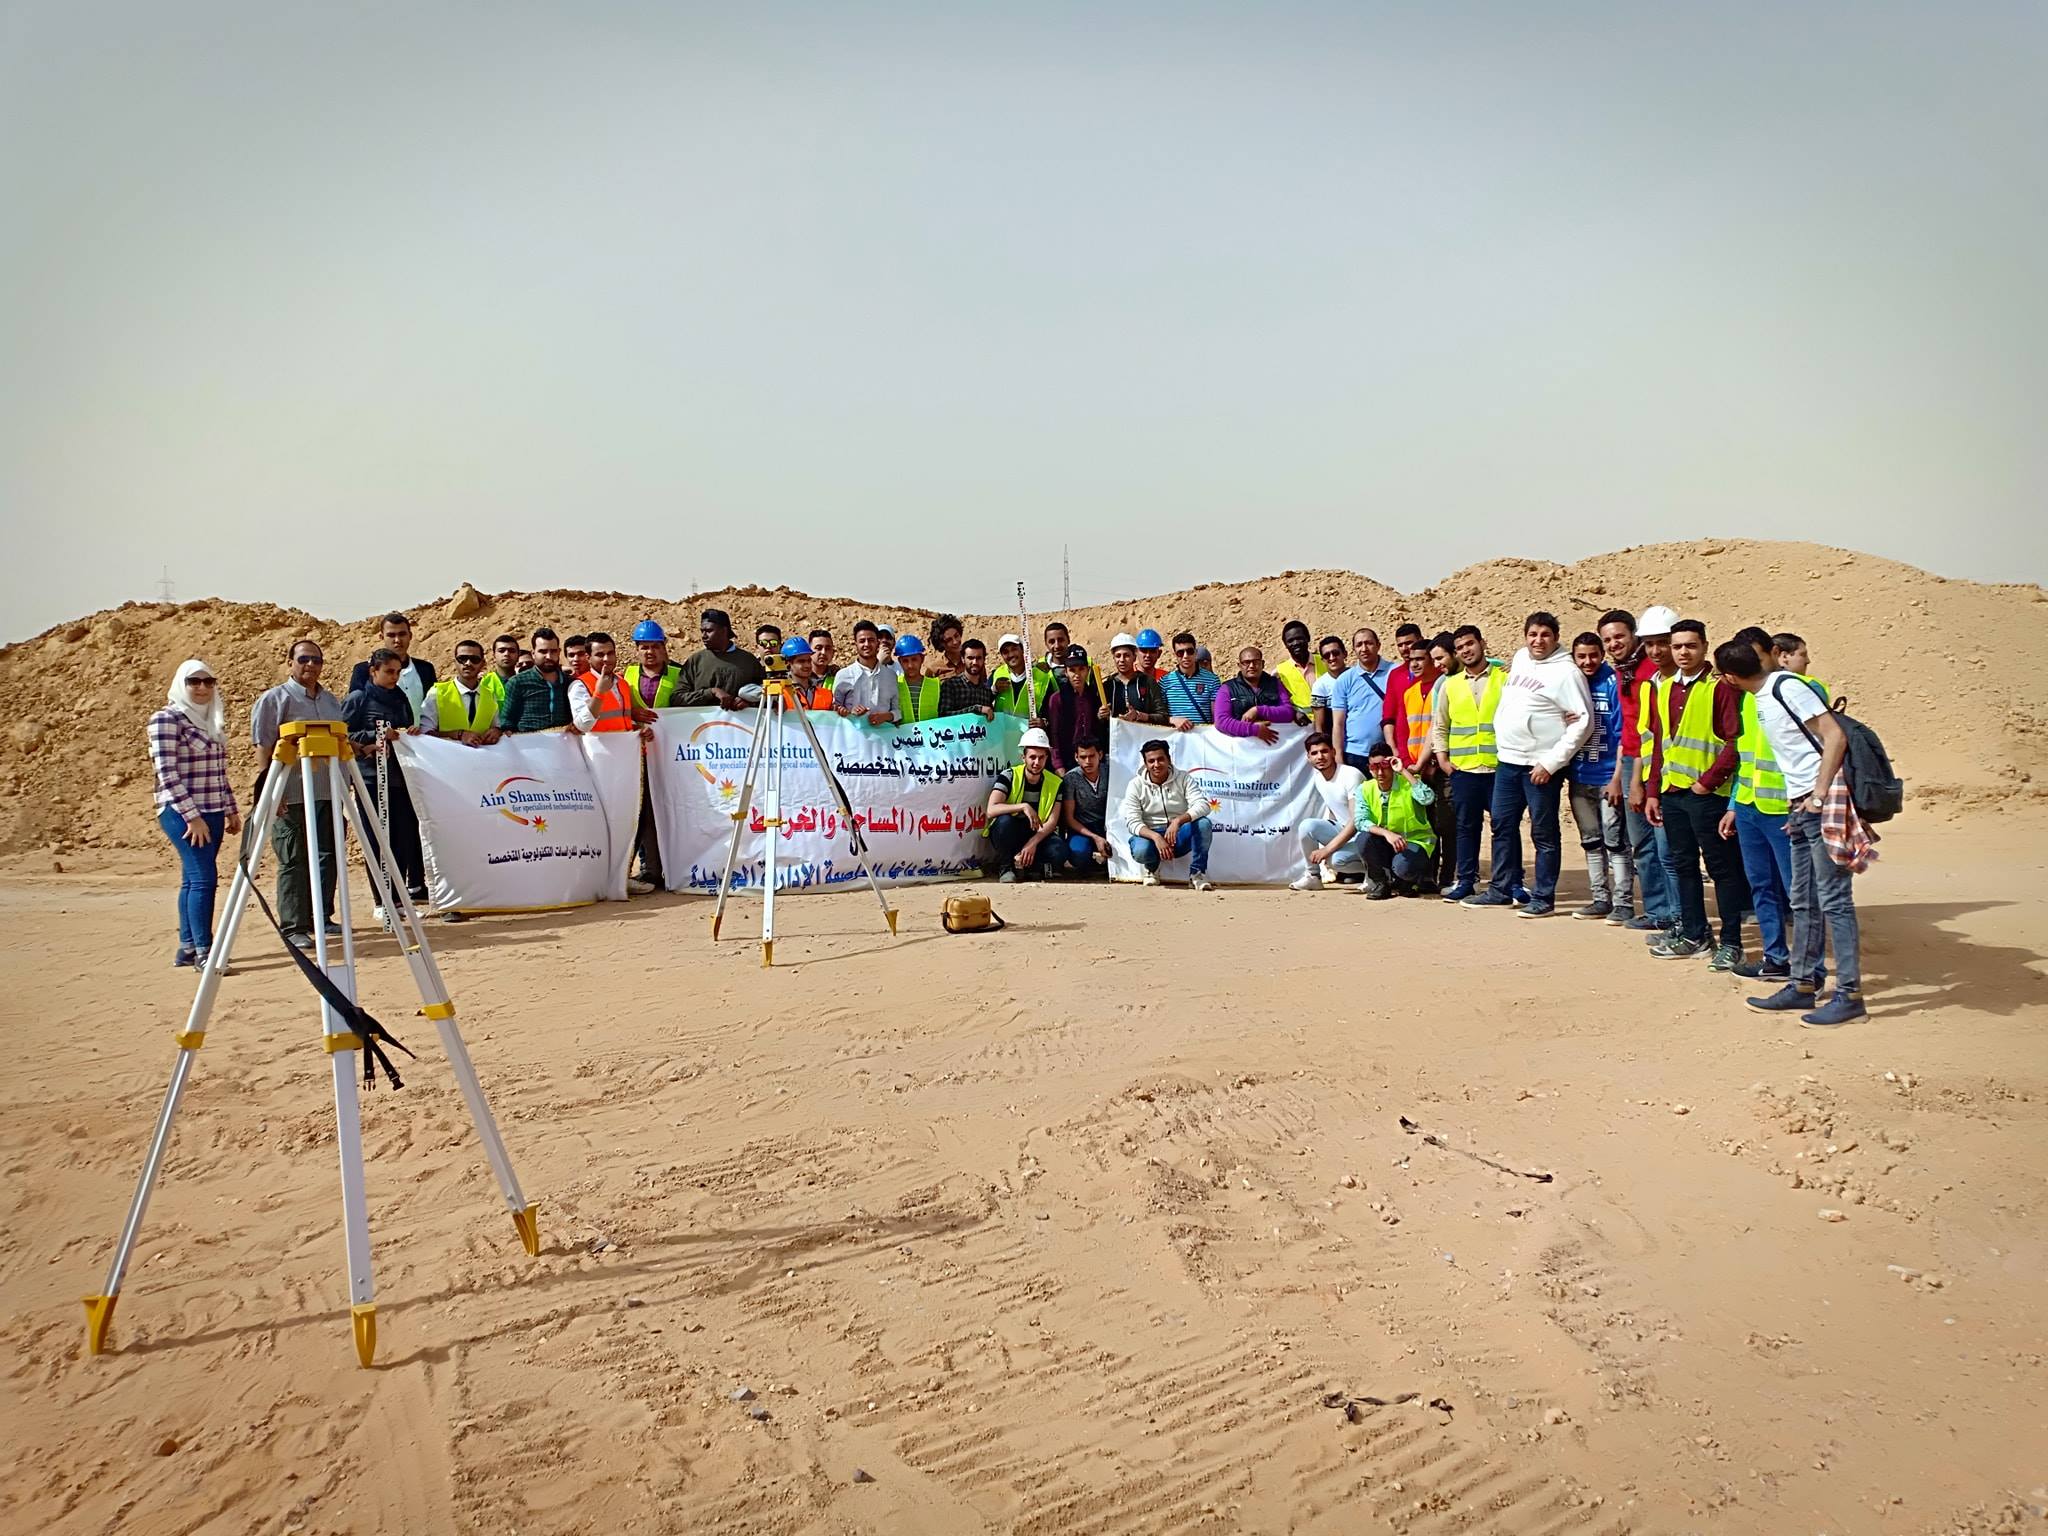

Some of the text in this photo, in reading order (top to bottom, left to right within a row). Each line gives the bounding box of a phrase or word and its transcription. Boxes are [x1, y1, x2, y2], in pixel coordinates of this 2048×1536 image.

[891, 723, 987, 750] معهد عين شمس
[675, 743, 701, 761] Ain
[834, 752, 905, 779] المتخصصة
[719, 761, 755, 772] specializd
[799, 761, 820, 769] studie
[907, 756, 984, 785] التكنولوجية
[480, 789, 593, 808] Ain Shams institute
[1233, 779, 1281, 791] institute
[918, 803, 953, 841] قسم
[954, 804, 986, 839] طلاب
